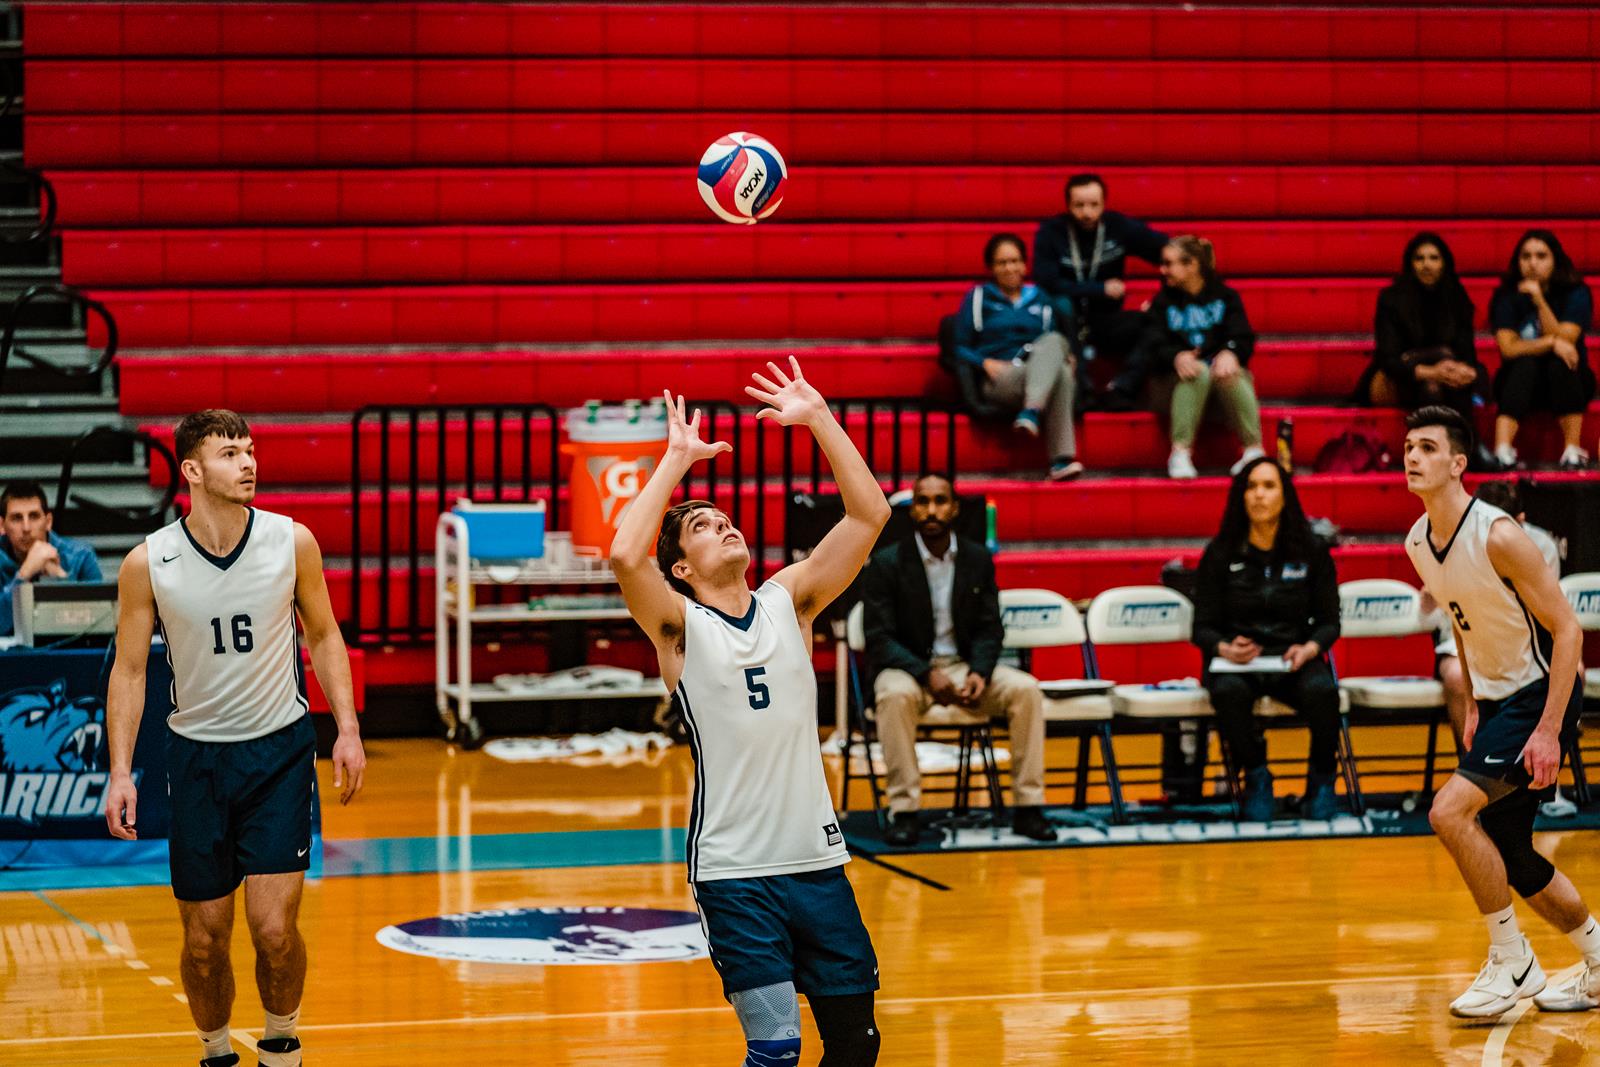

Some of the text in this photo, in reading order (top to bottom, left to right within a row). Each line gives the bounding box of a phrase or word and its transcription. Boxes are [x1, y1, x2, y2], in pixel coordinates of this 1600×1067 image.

[739, 168, 765, 200] NCAA
[1001, 605, 1062, 630] ARUCH
[1449, 601, 1471, 631] 2
[211, 614, 254, 655] 16
[744, 666, 770, 710] 5
